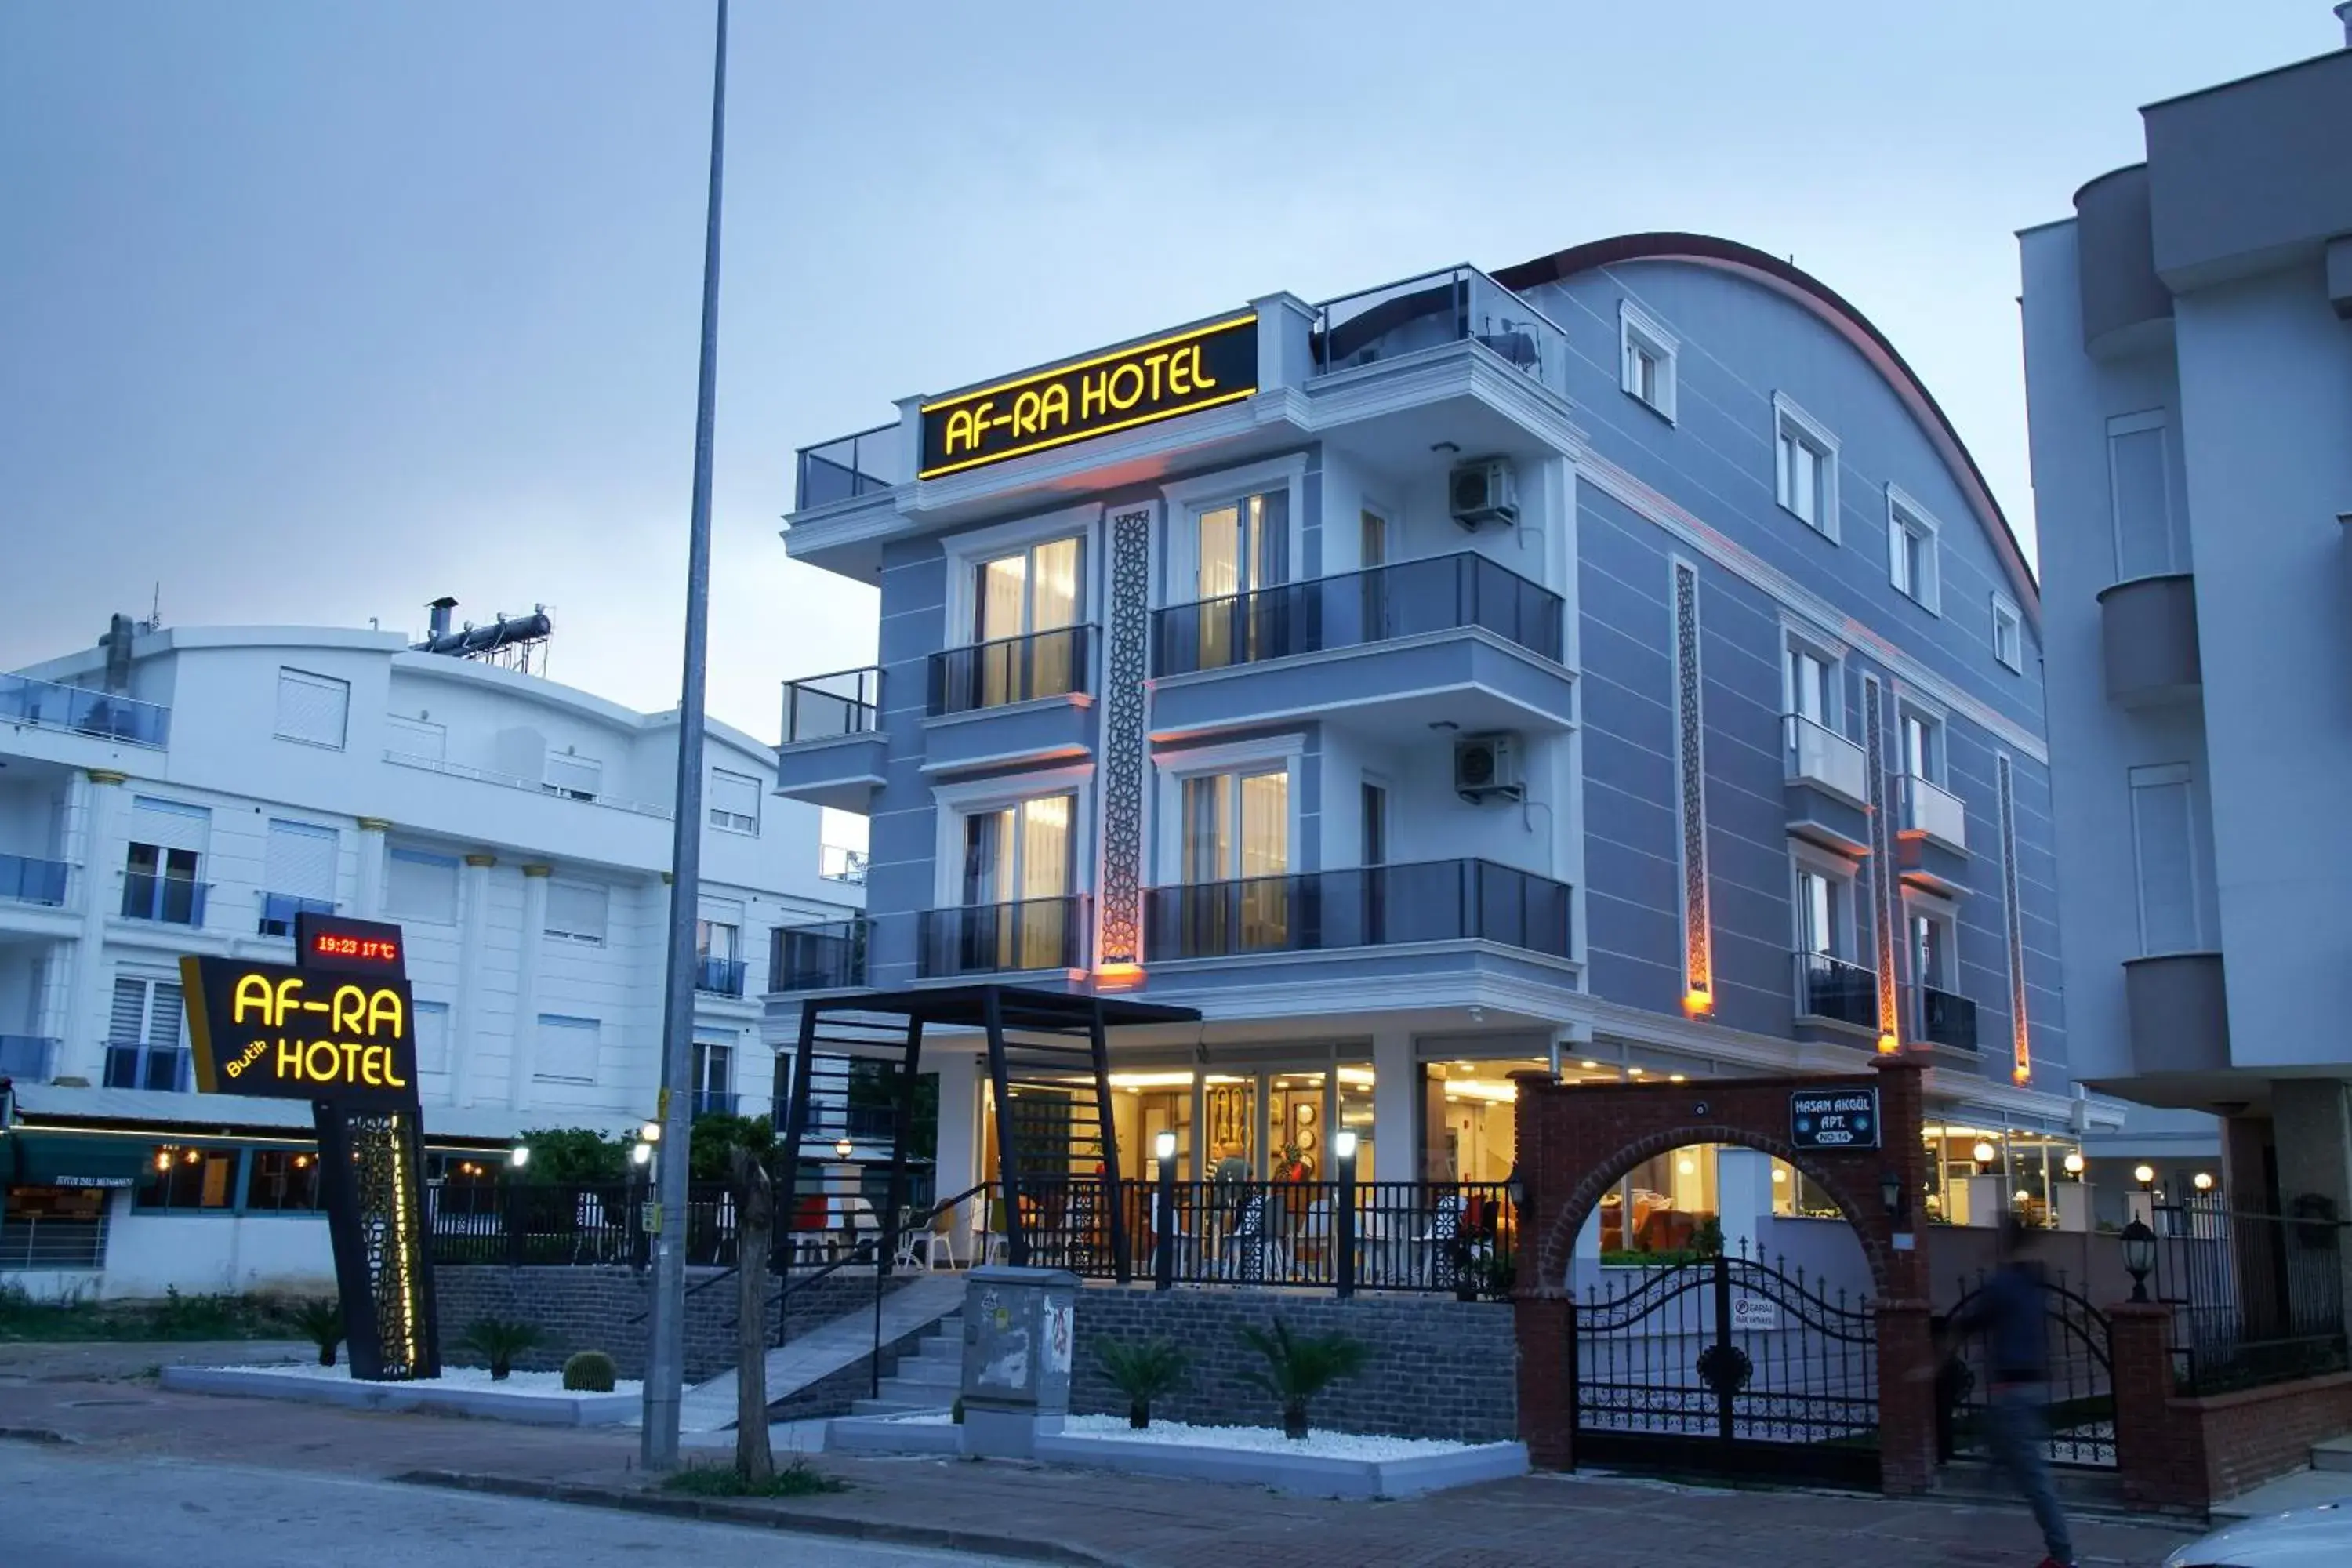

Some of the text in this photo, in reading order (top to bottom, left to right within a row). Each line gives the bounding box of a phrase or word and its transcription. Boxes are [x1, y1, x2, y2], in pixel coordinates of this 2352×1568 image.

[946, 343, 1216, 456] AF-RA HOTEL
[319, 936, 357, 954] 19:23
[234, 974, 403, 1038] AF-RA
[226, 1038, 405, 1087] Butik HOTEL
[1795, 1099, 1831, 1114] HASAN
[1820, 1116, 1846, 1129] APT.
